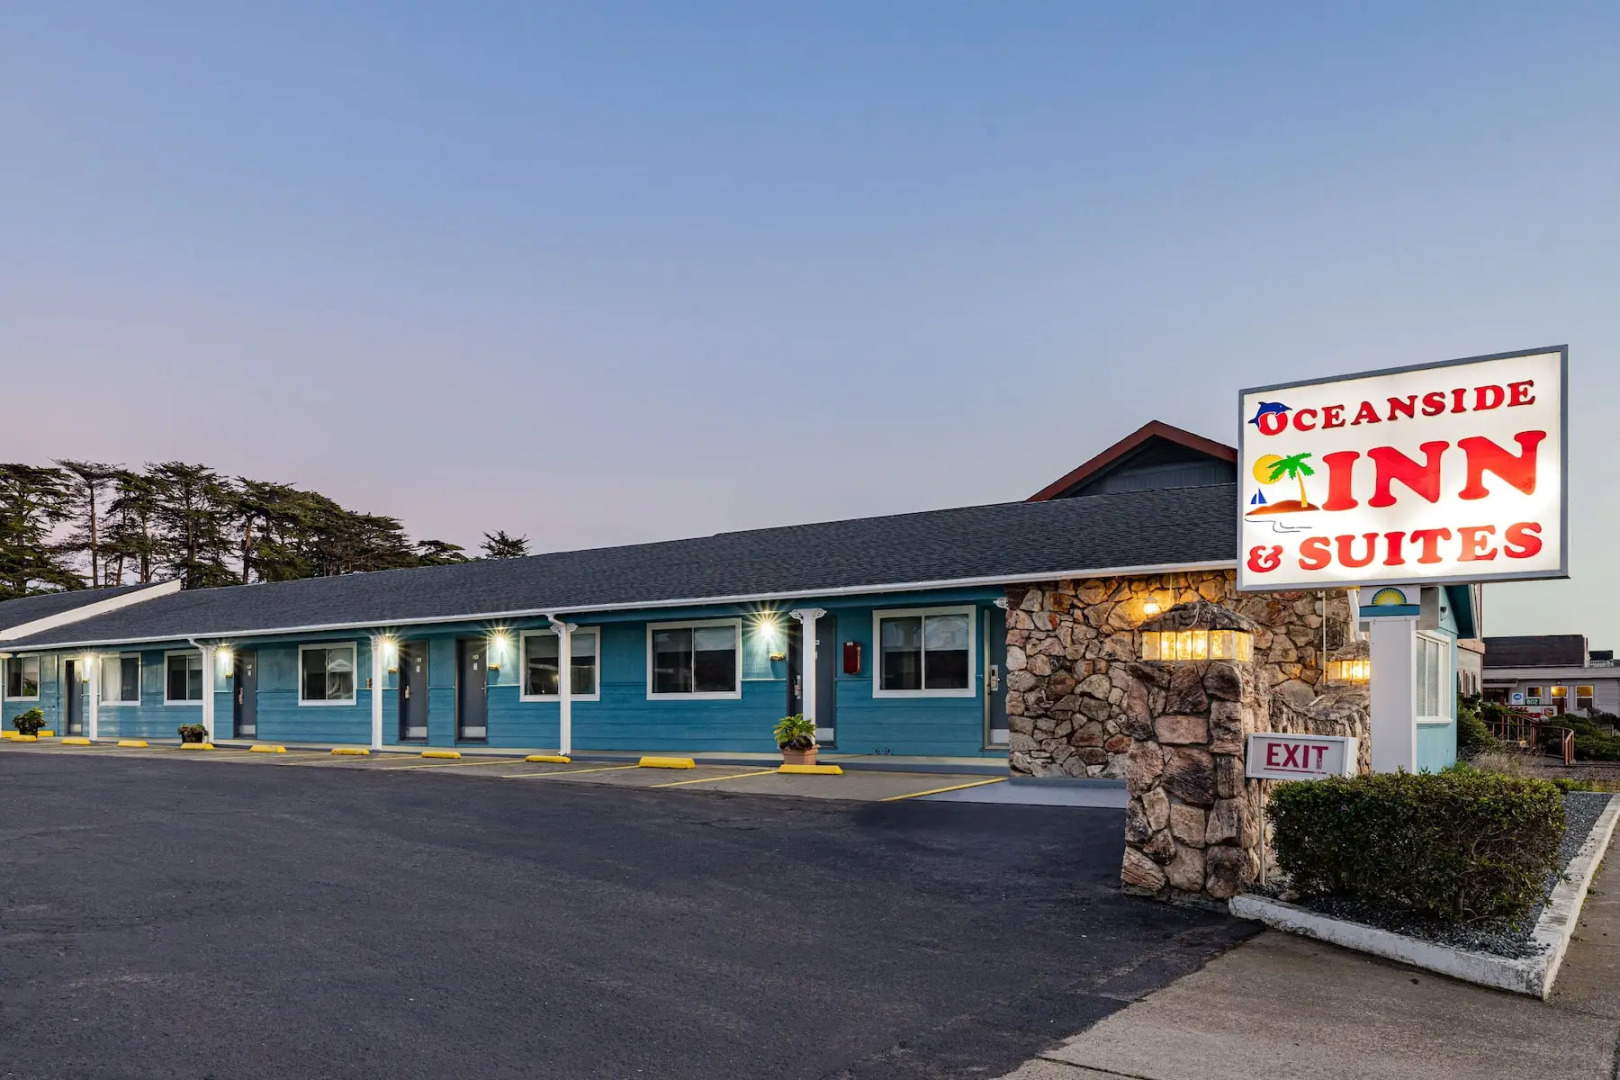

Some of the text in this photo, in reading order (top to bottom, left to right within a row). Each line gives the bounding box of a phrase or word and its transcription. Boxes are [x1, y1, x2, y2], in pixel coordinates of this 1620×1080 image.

[1258, 379, 1536, 437] OCEANSIDE
[1321, 430, 1547, 512] INN
[1246, 521, 1544, 574] & SUITES
[1266, 742, 1329, 770] EXIT
